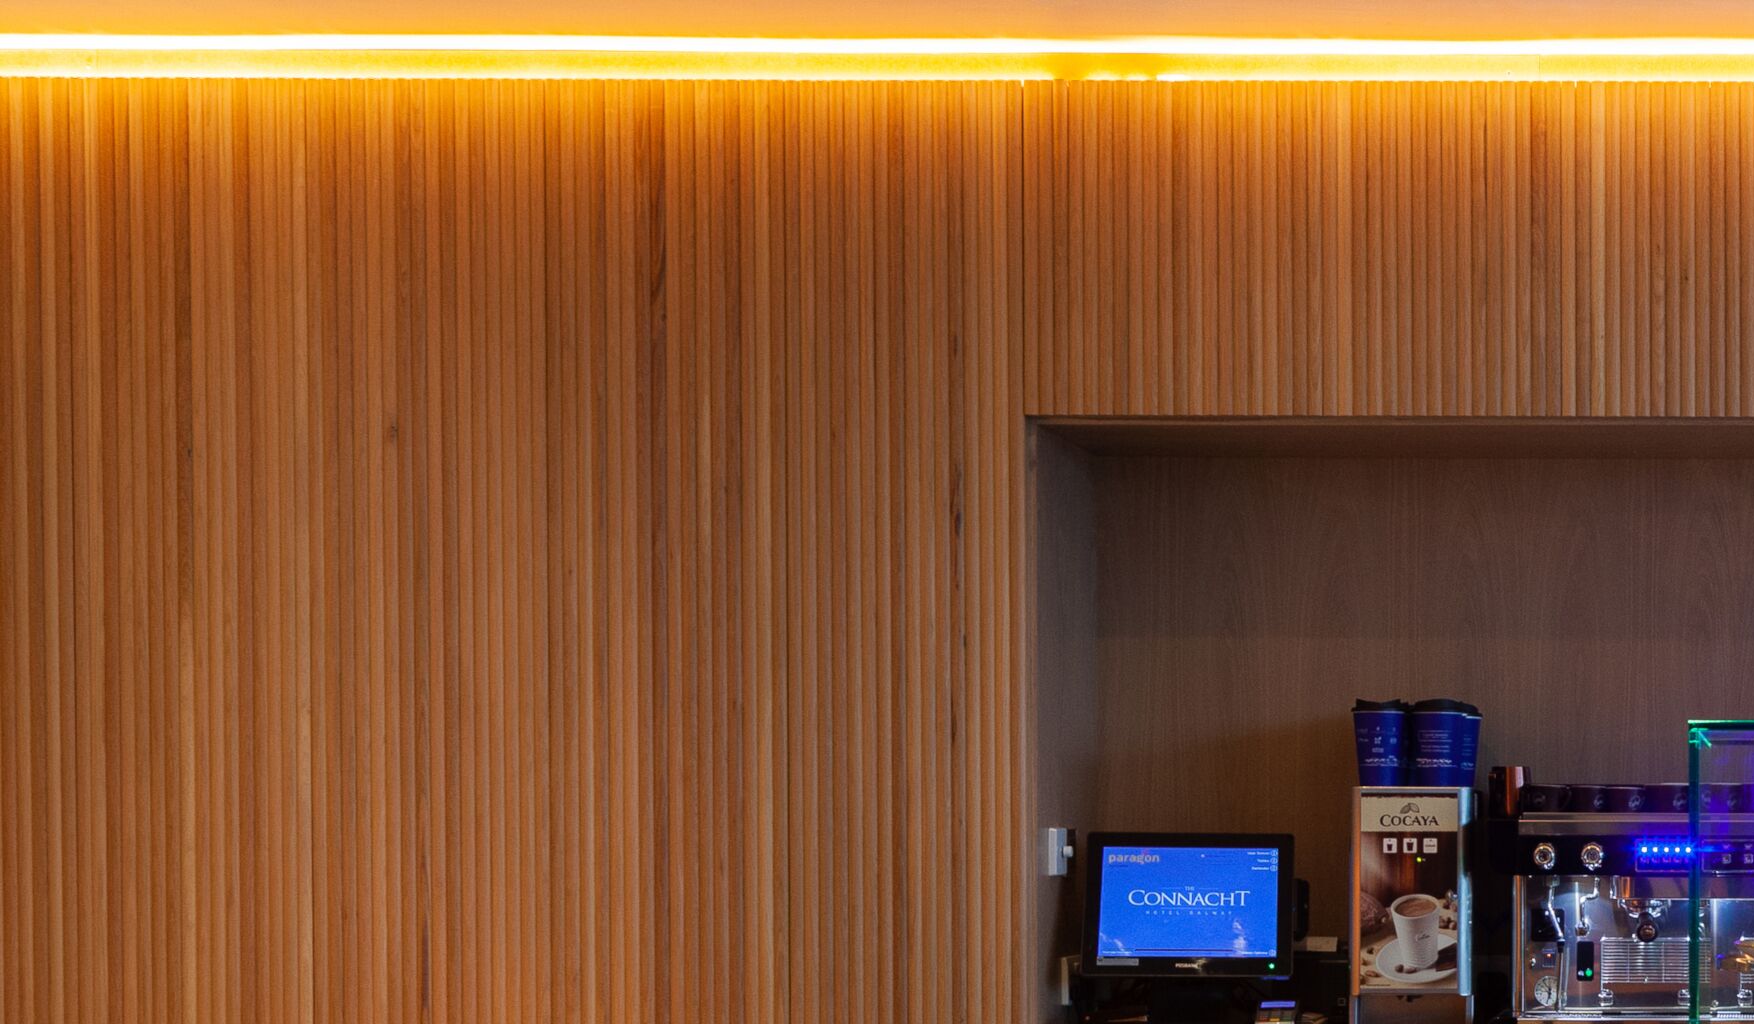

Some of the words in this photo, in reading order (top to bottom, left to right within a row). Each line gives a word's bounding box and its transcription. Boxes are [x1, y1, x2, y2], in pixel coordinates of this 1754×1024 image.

[1380, 814, 1439, 827] COCAYA
[1108, 853, 1160, 864] paragon
[1128, 889, 1250, 907] CONNACHT
